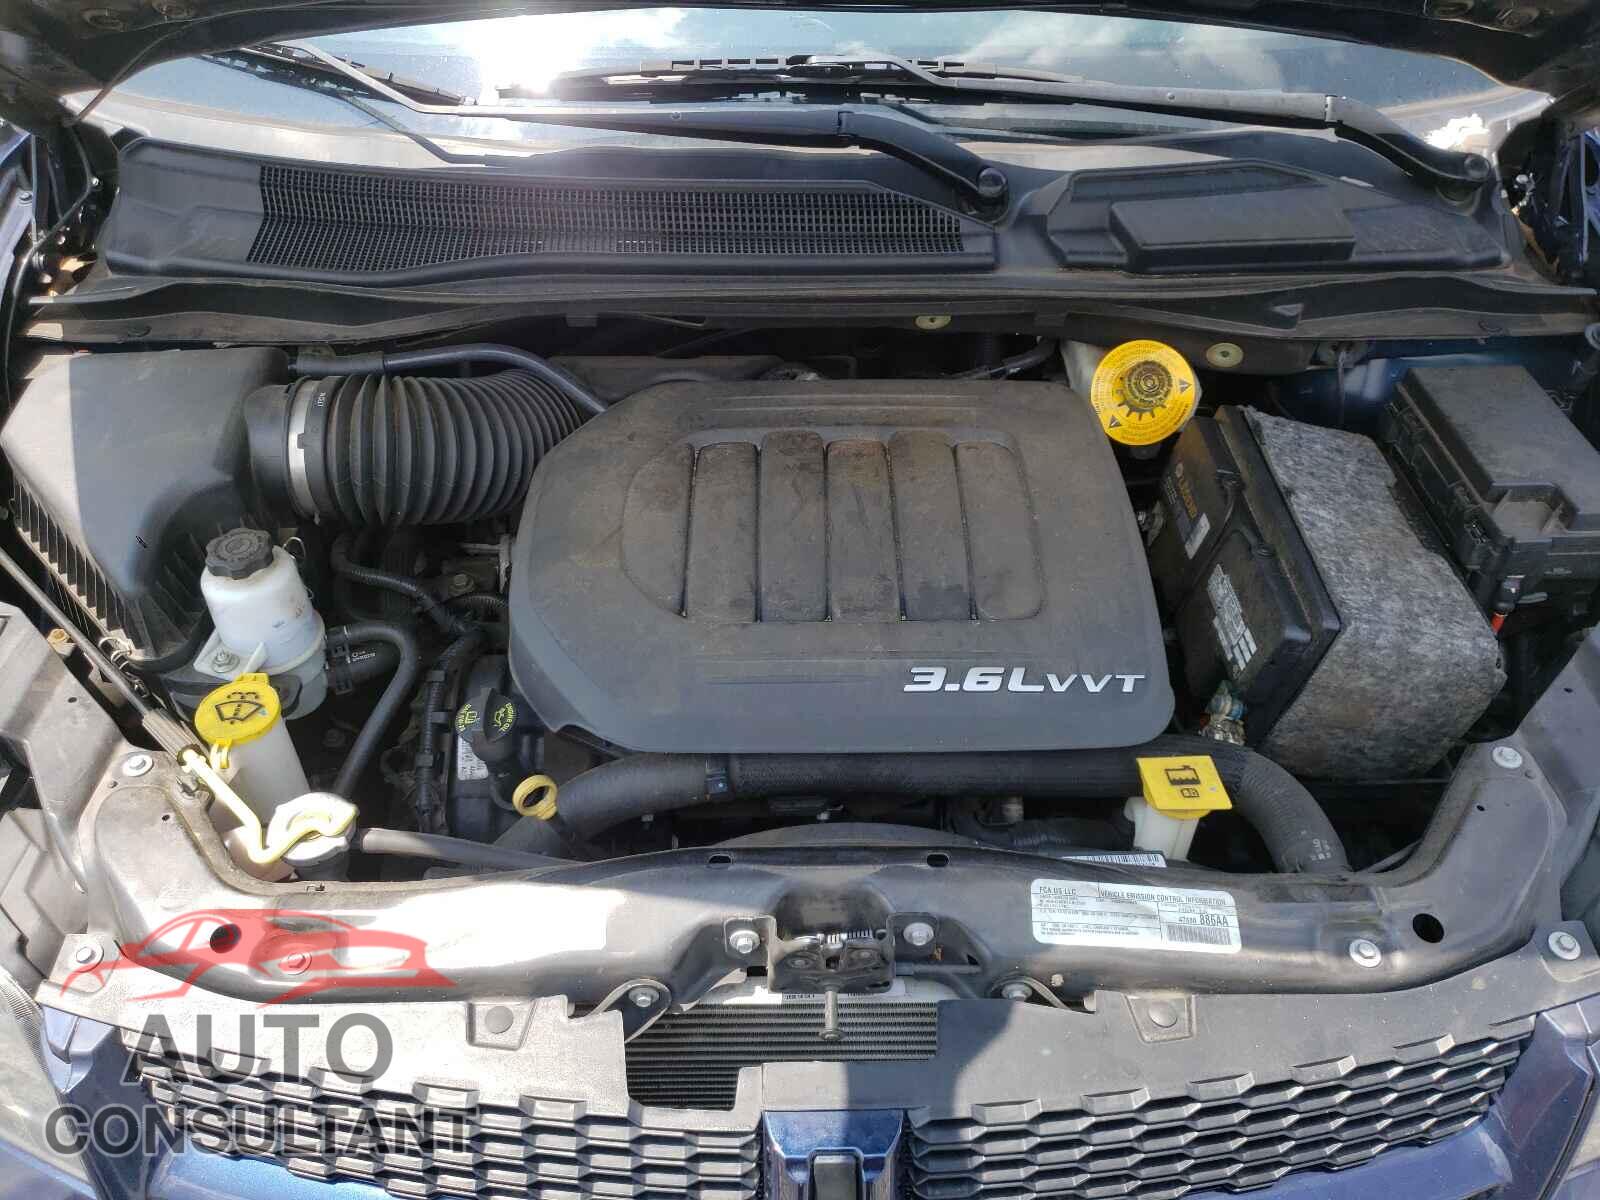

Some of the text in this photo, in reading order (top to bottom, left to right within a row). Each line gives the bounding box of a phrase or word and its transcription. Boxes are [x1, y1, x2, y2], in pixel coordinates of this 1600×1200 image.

[903, 667, 1145, 692] 3.6L VVT
[1039, 886, 1052, 895] FCA
[1100, 888, 1124, 898] VEHICLE
[1126, 892, 1155, 901] EMISSION
[1156, 894, 1184, 904] CONTROL
